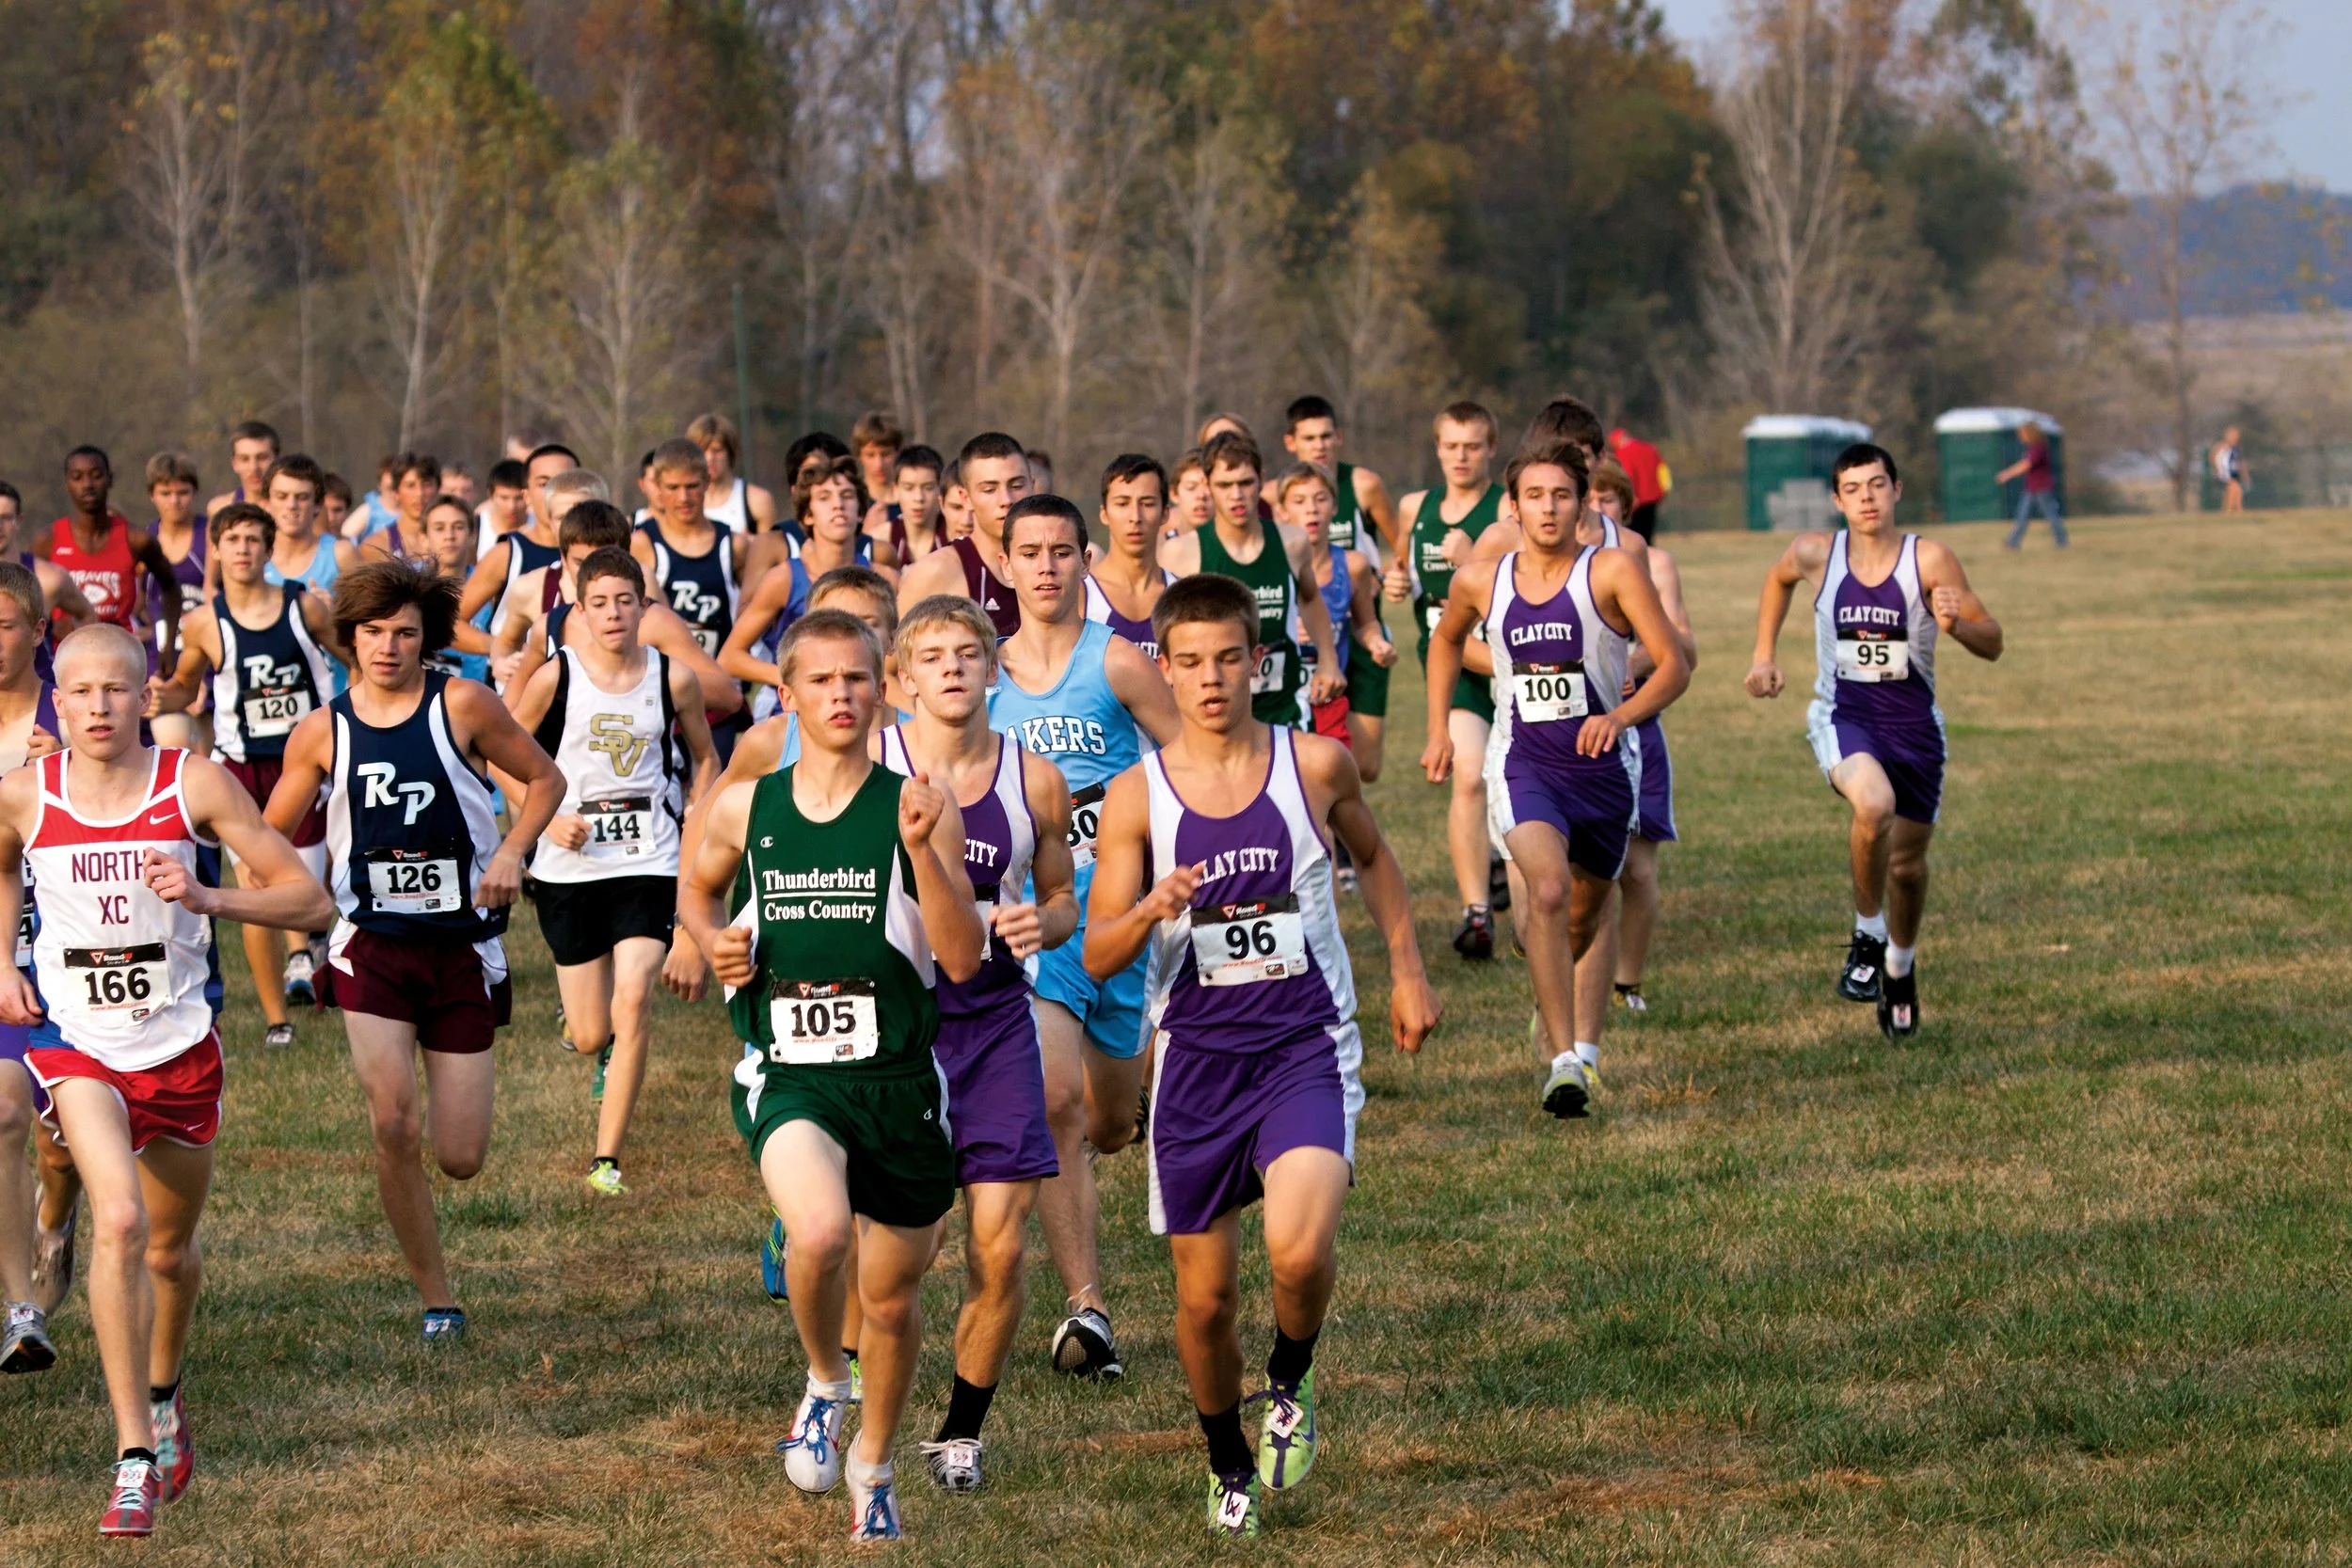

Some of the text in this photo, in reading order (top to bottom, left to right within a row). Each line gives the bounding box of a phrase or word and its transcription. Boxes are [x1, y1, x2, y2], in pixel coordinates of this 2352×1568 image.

[672, 580, 721, 623] RP
[1839, 606, 1899, 626] CLAY CITY
[1511, 623, 1572, 646] CLAY CITY
[1857, 644, 1889, 666] 95
[1525, 677, 1570, 702] 100
[260, 697, 297, 720] 120
[589, 713, 649, 777] SV
[357, 762, 436, 825] RP
[594, 815, 640, 842] 144
[72, 850, 145, 883] NORTH
[387, 863, 441, 894] 126
[762, 867, 876, 891] Thunderbird
[1198, 847, 1279, 887] LAY CITY
[98, 895, 129, 925] XC
[764, 900, 876, 924] Cross Country
[1225, 920, 1277, 959] 96
[85, 967, 151, 1005] 166
[791, 1001, 856, 1037] 105
